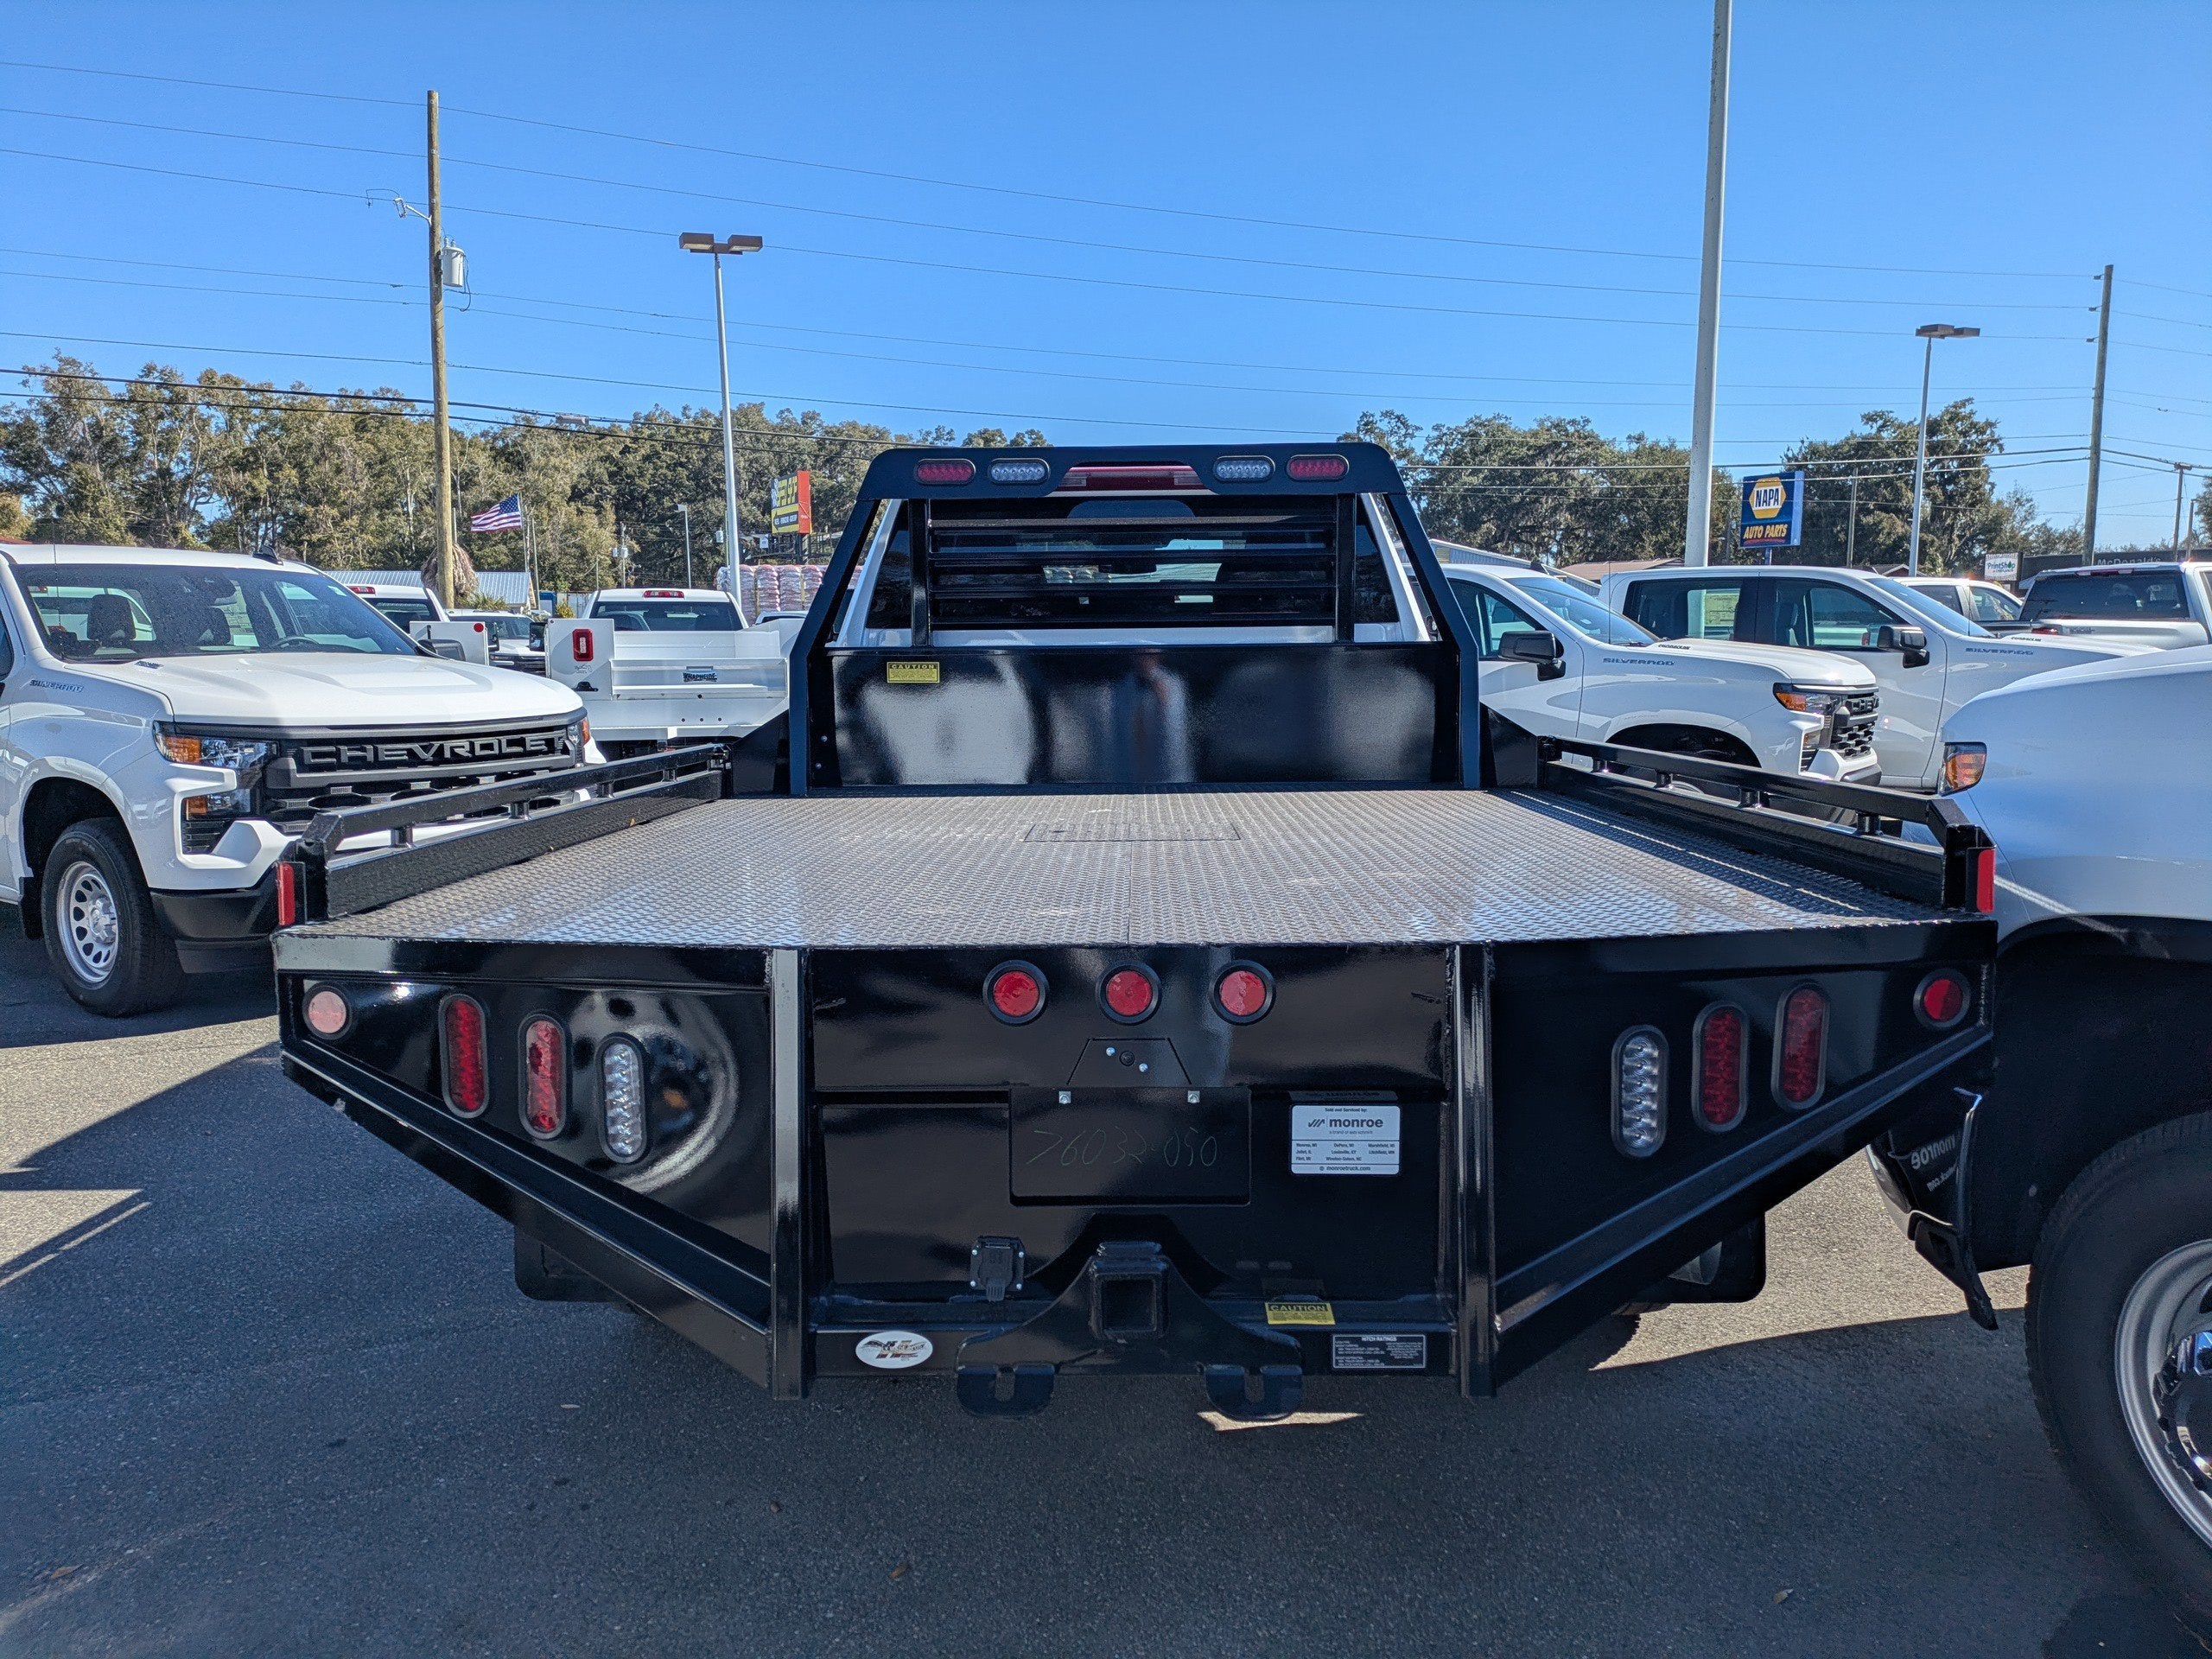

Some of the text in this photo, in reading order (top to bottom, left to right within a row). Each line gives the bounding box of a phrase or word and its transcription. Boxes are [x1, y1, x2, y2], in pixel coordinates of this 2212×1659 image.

[1755, 488, 1779, 508] NAPA
[1743, 524, 1788, 539] AUTO PARTS
[2097, 557, 2161, 566] McDonald's
[302, 731, 566, 765] CHEVROLET
[1329, 1118, 1383, 1128] monroe
